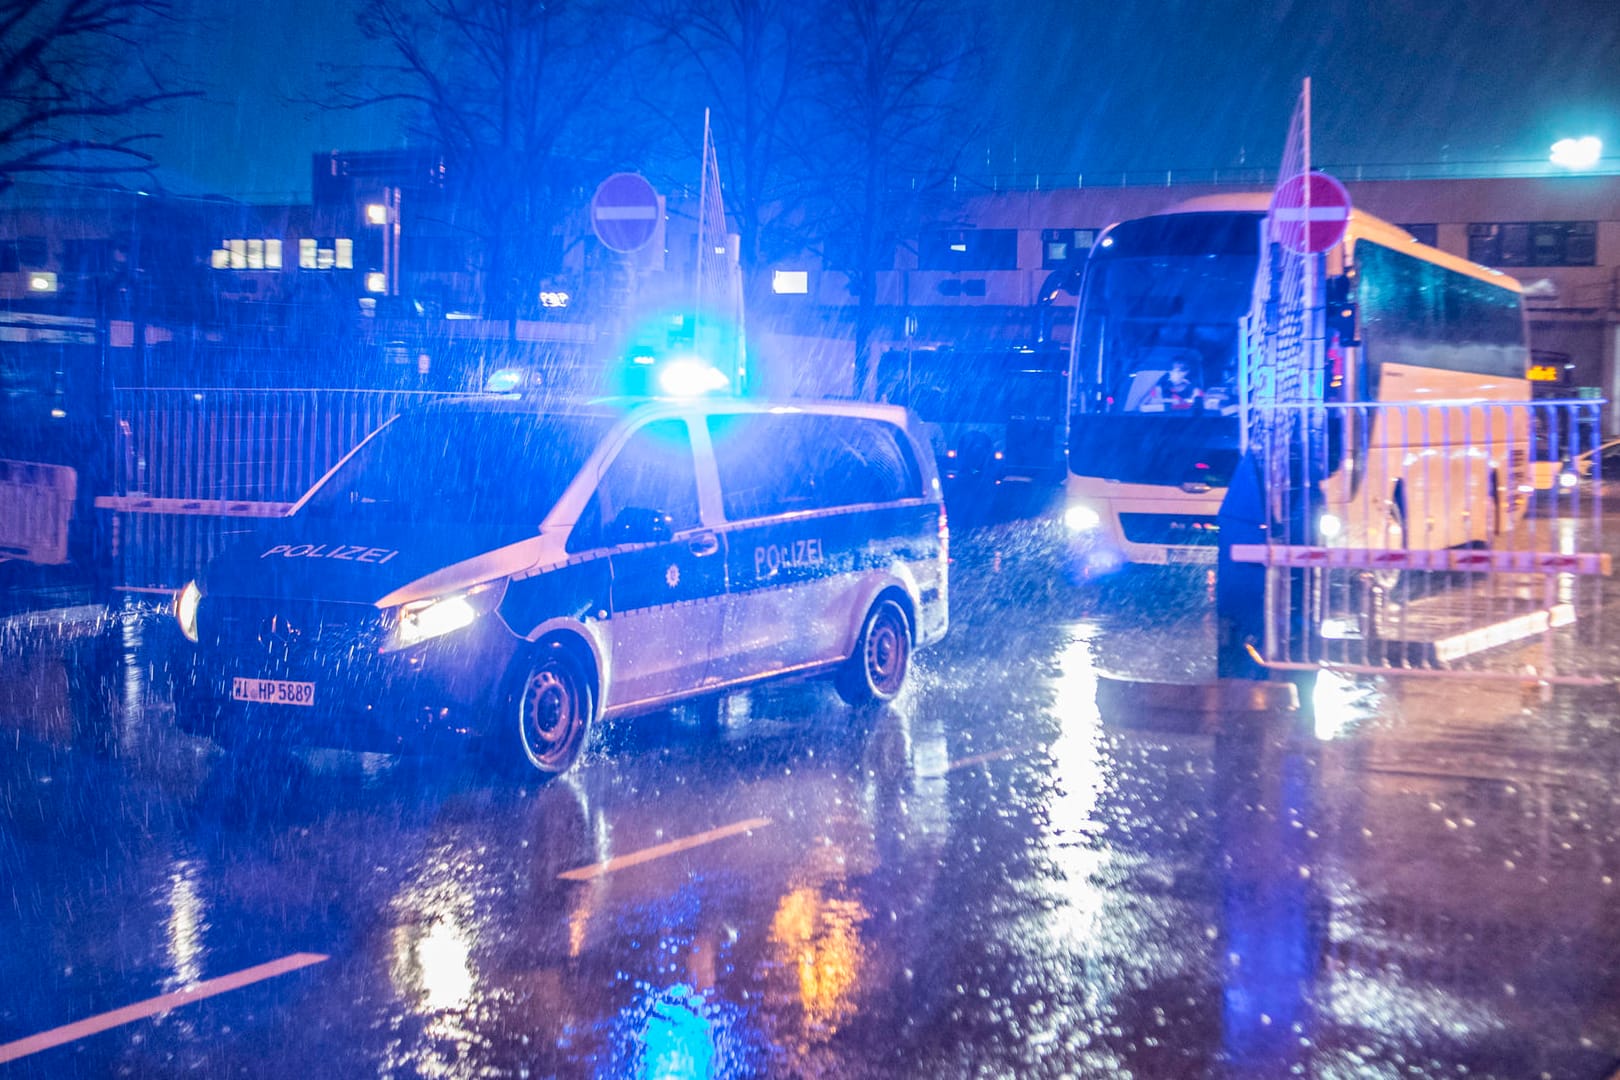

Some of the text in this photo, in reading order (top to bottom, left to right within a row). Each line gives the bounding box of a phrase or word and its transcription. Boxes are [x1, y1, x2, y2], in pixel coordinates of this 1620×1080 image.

[260, 544, 399, 564] POLIZEI
[754, 538, 824, 577] POLIZEI
[259, 682, 276, 701] HP
[278, 683, 313, 703] 5889
